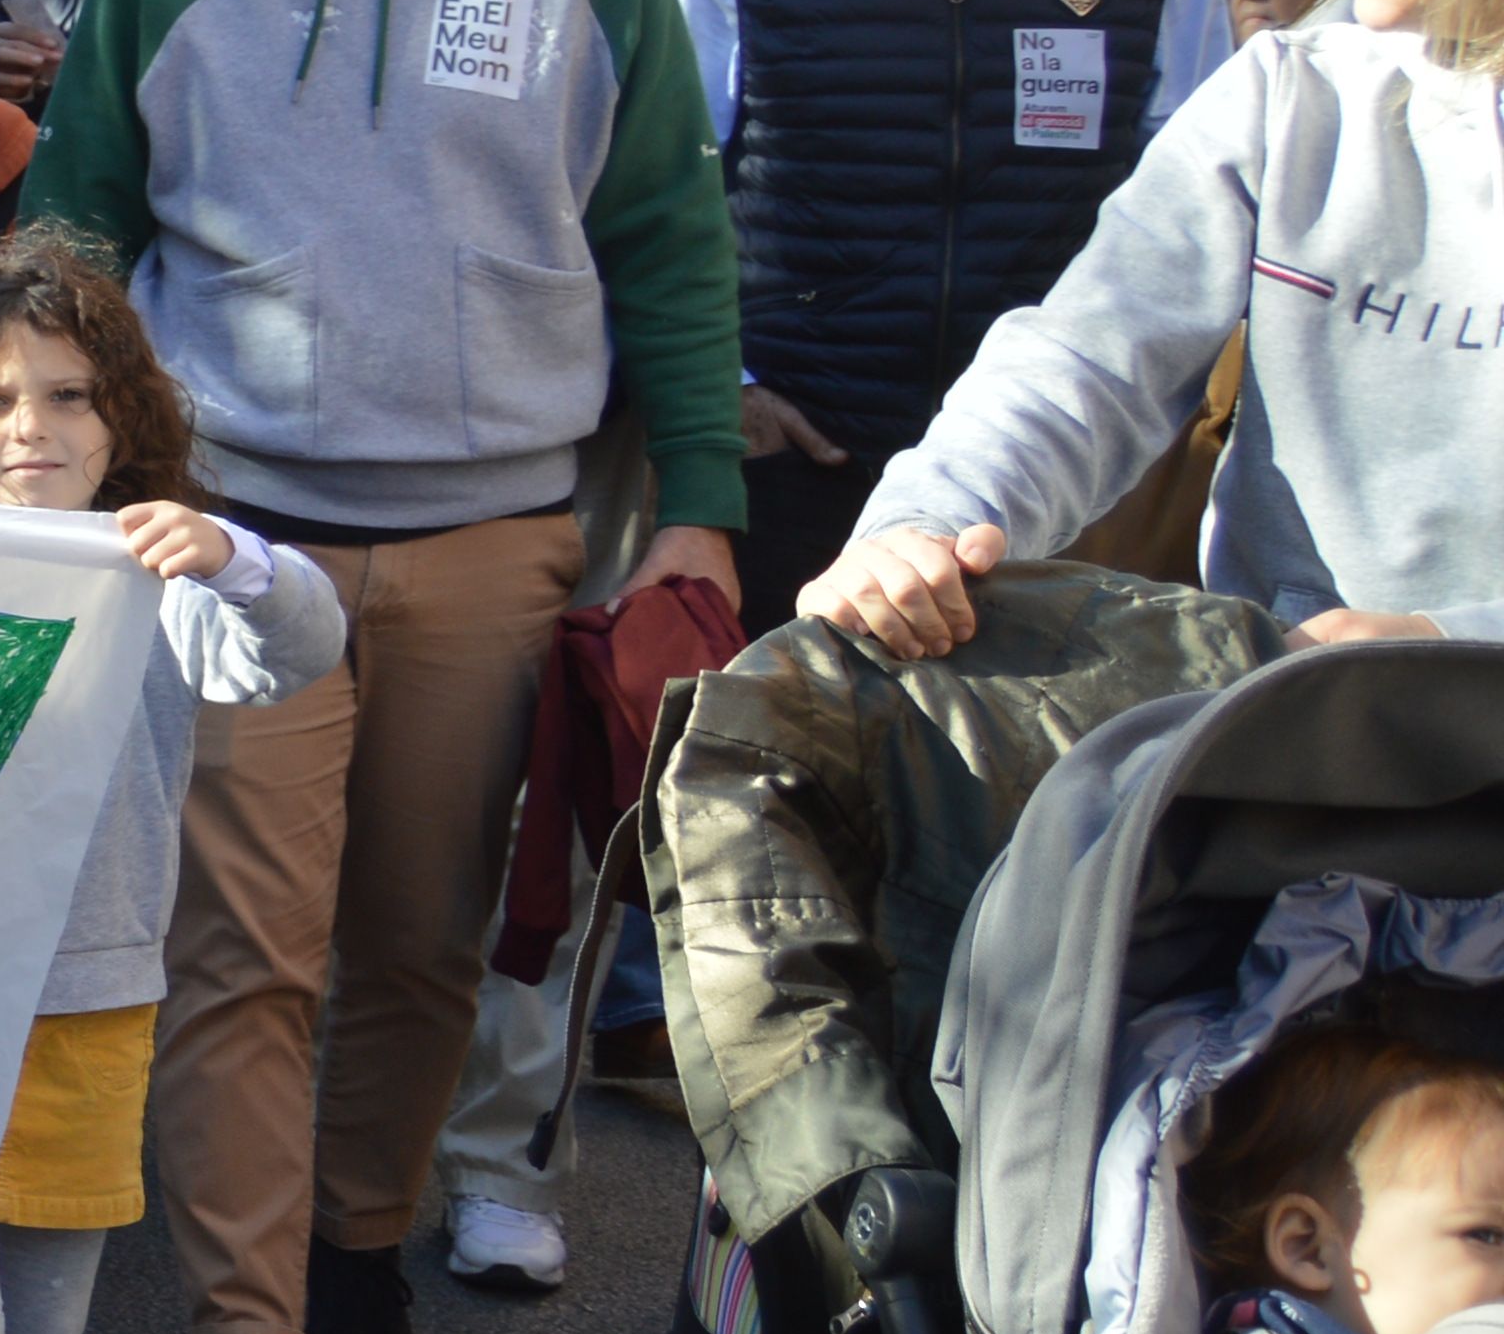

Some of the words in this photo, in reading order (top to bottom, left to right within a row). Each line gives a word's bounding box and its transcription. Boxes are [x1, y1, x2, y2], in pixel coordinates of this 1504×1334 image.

[435, 22, 508, 54] Meu
[1020, 32, 1055, 50] No
[431, 47, 510, 82] Nom
[1021, 56, 1035, 71] a
[1041, 52, 1062, 71] la
[1020, 77, 1099, 98] guerra
[1353, 283, 1504, 350] HIL
